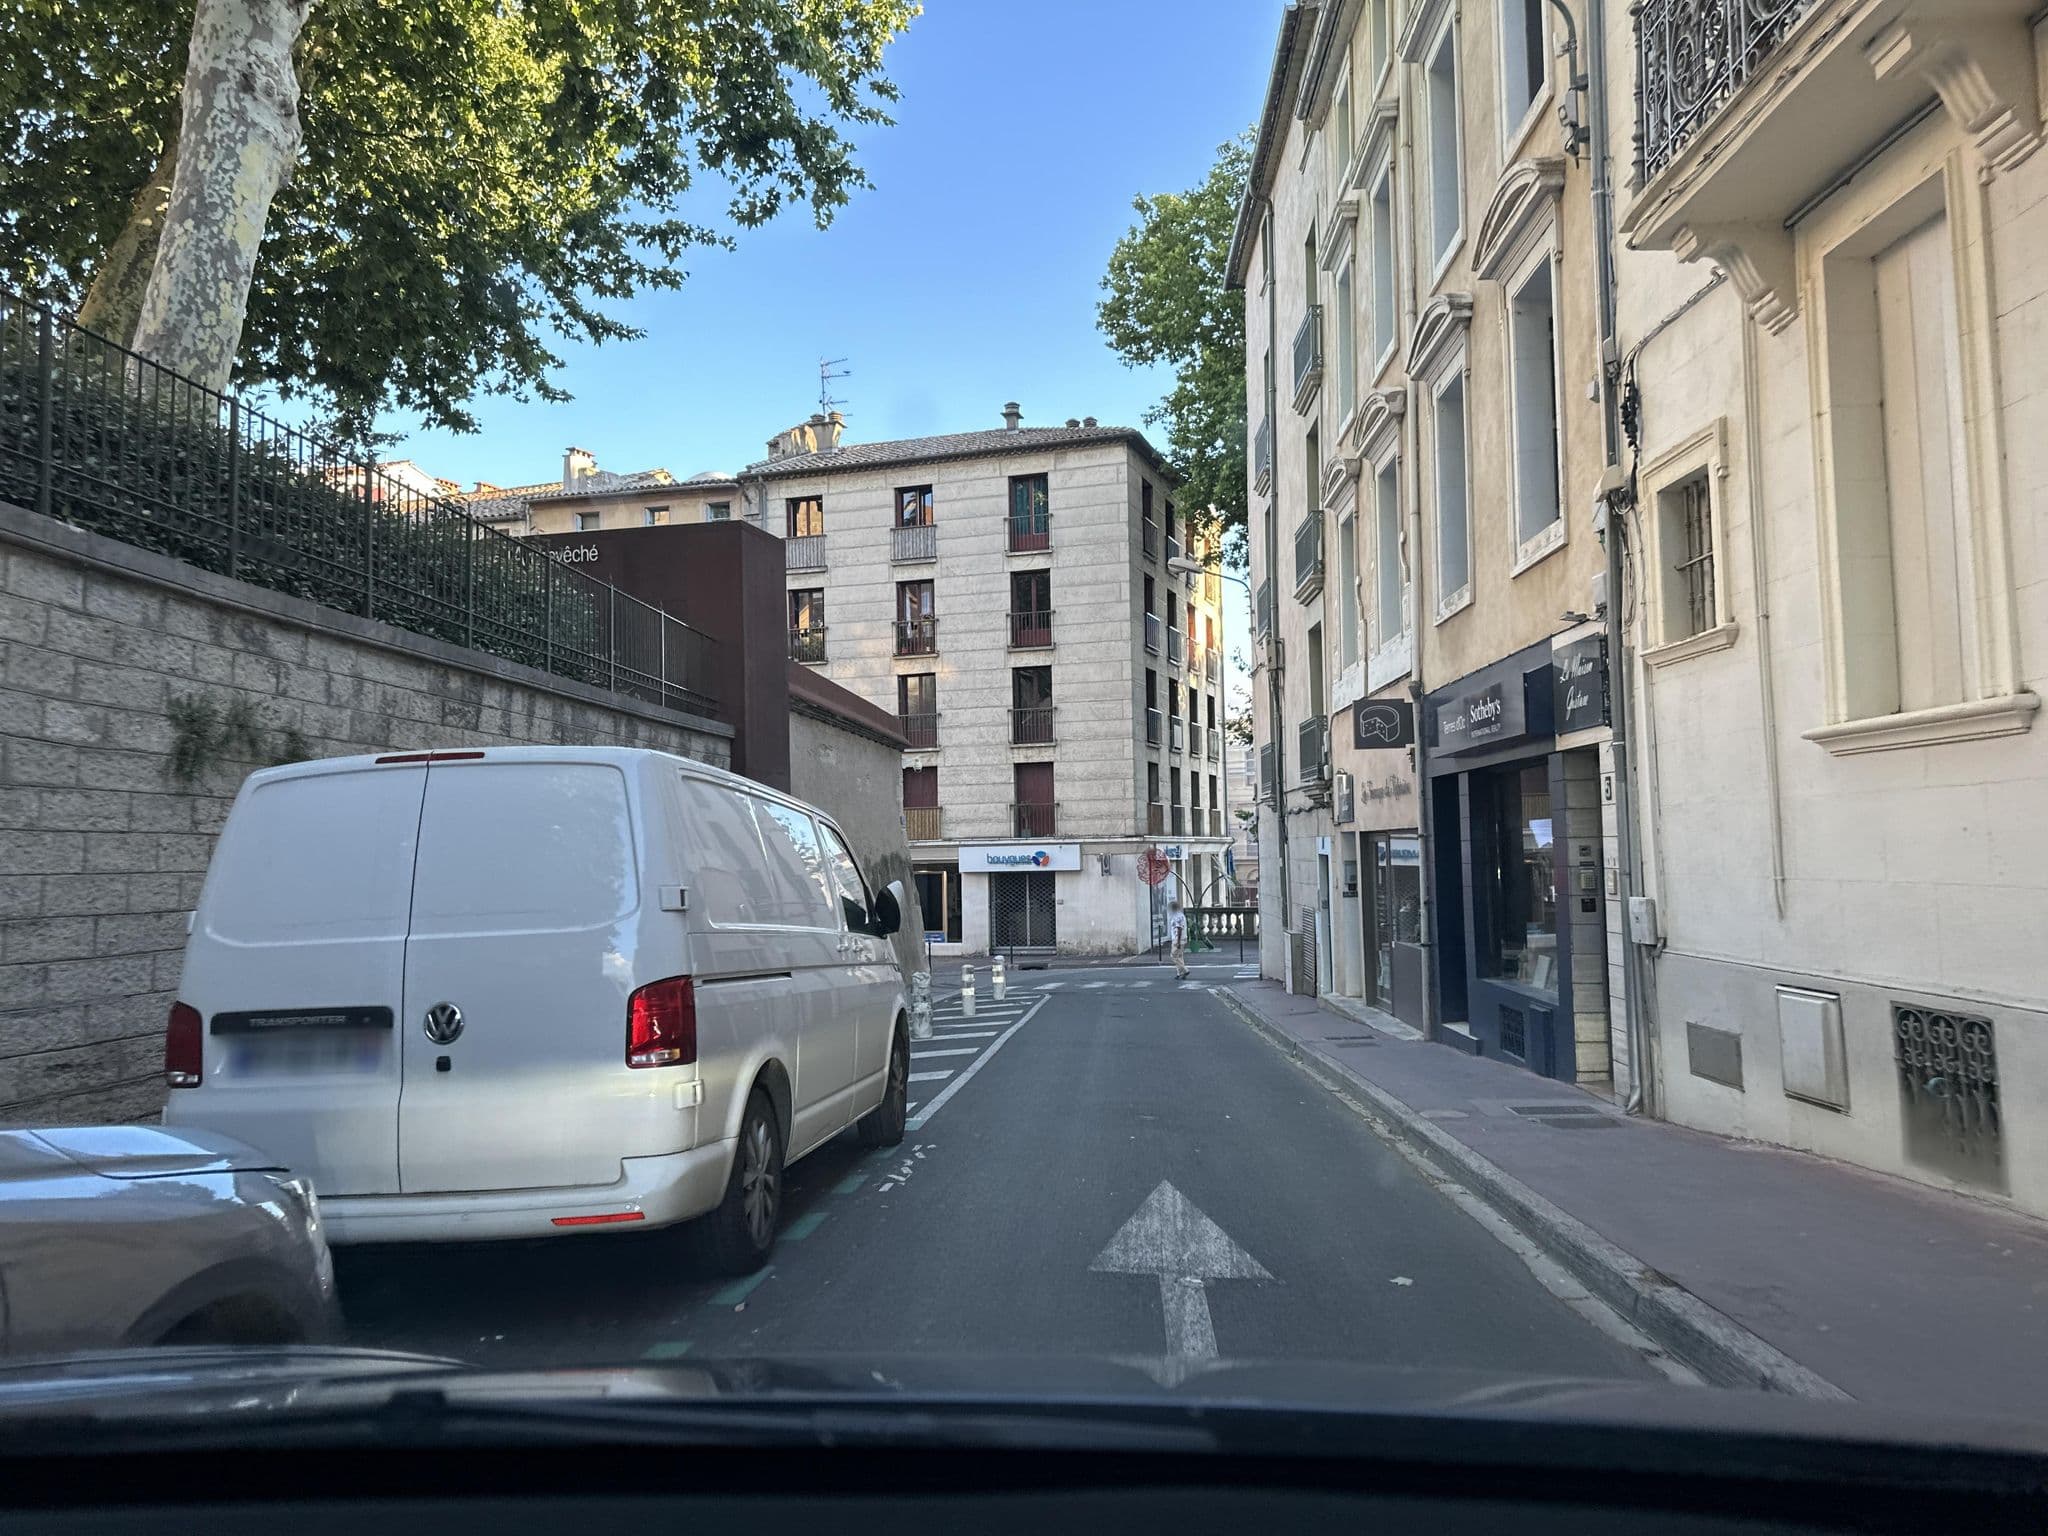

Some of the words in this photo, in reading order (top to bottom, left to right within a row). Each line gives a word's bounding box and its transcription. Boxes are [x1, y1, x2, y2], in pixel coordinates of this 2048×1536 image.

[1470, 696, 1501, 723] Sotheby's
[986, 853, 1032, 867] bouygues
[249, 1015, 347, 1027] TRANSPORTER
